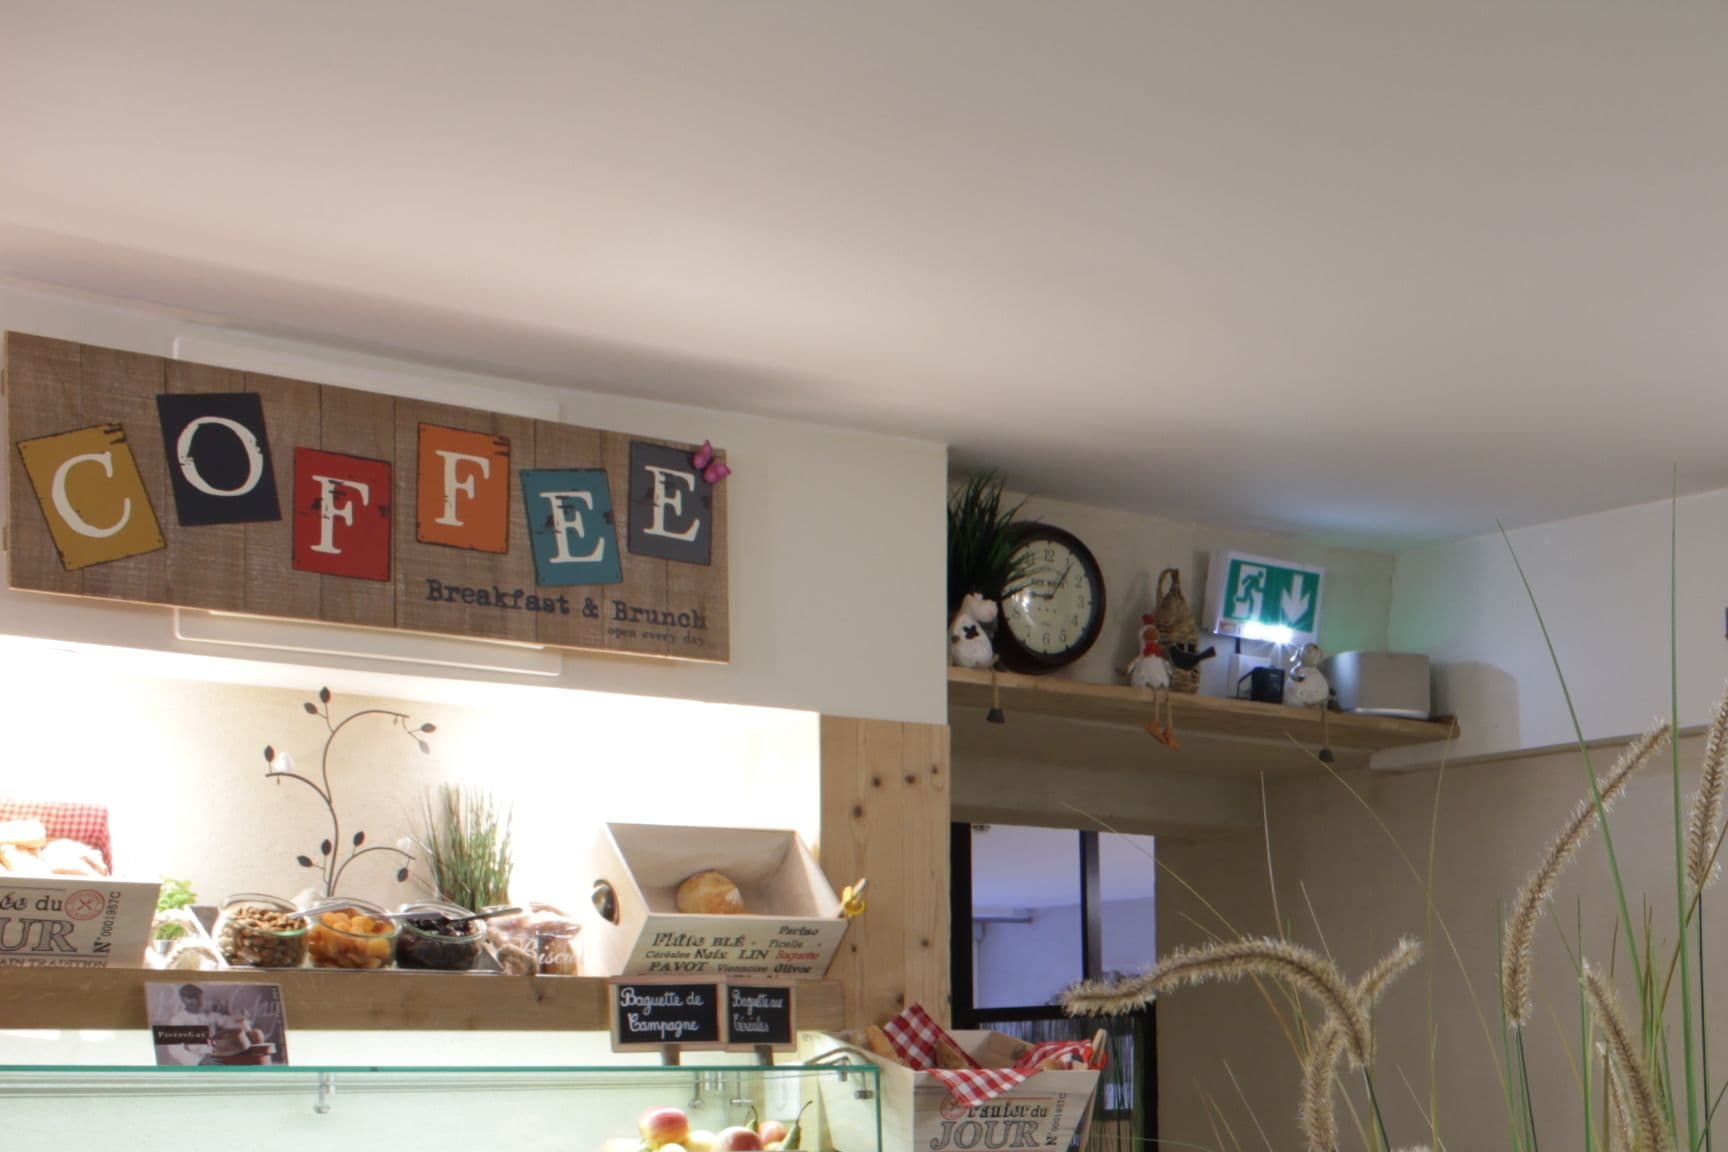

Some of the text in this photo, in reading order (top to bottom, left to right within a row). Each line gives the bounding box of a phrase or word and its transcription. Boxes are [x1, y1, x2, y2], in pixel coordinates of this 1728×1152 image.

[51, 415, 701, 566] COFFEE
[425, 579, 708, 631] Breakfast & Brunch
[35, 895, 63, 912] du
[0, 916, 78, 953] UR
[712, 935, 745, 948] BLÉ
[647, 961, 709, 973] PAVOT
[738, 949, 769, 960] LIN
[620, 986, 705, 1015] Baguette de
[731, 988, 769, 1016] Baguette
[627, 1012, 700, 1041] Campagne
[1030, 1104, 1048, 1119] du
[928, 1119, 1040, 1151] JOUR
